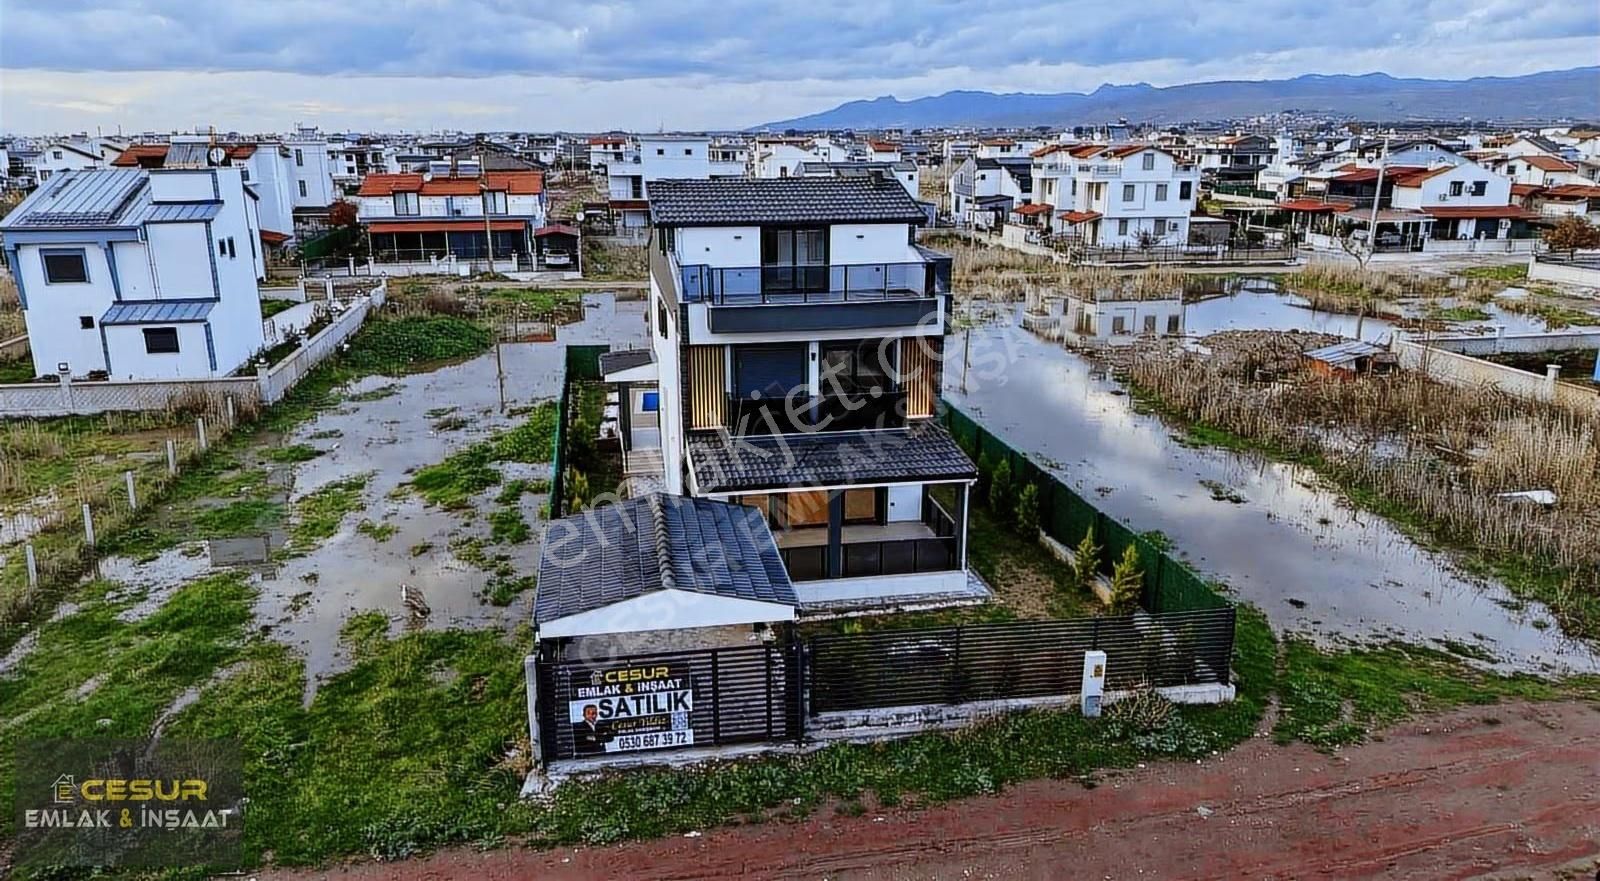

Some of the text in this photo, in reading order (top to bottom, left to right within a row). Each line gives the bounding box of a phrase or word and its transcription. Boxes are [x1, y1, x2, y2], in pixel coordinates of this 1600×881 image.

[606, 667, 669, 683] CESUR
[578, 687, 621, 698] EMLAK
[624, 683, 634, 693] &
[598, 691, 690, 718] SATILIK
[619, 732, 687, 749] 0530 687 39 72
